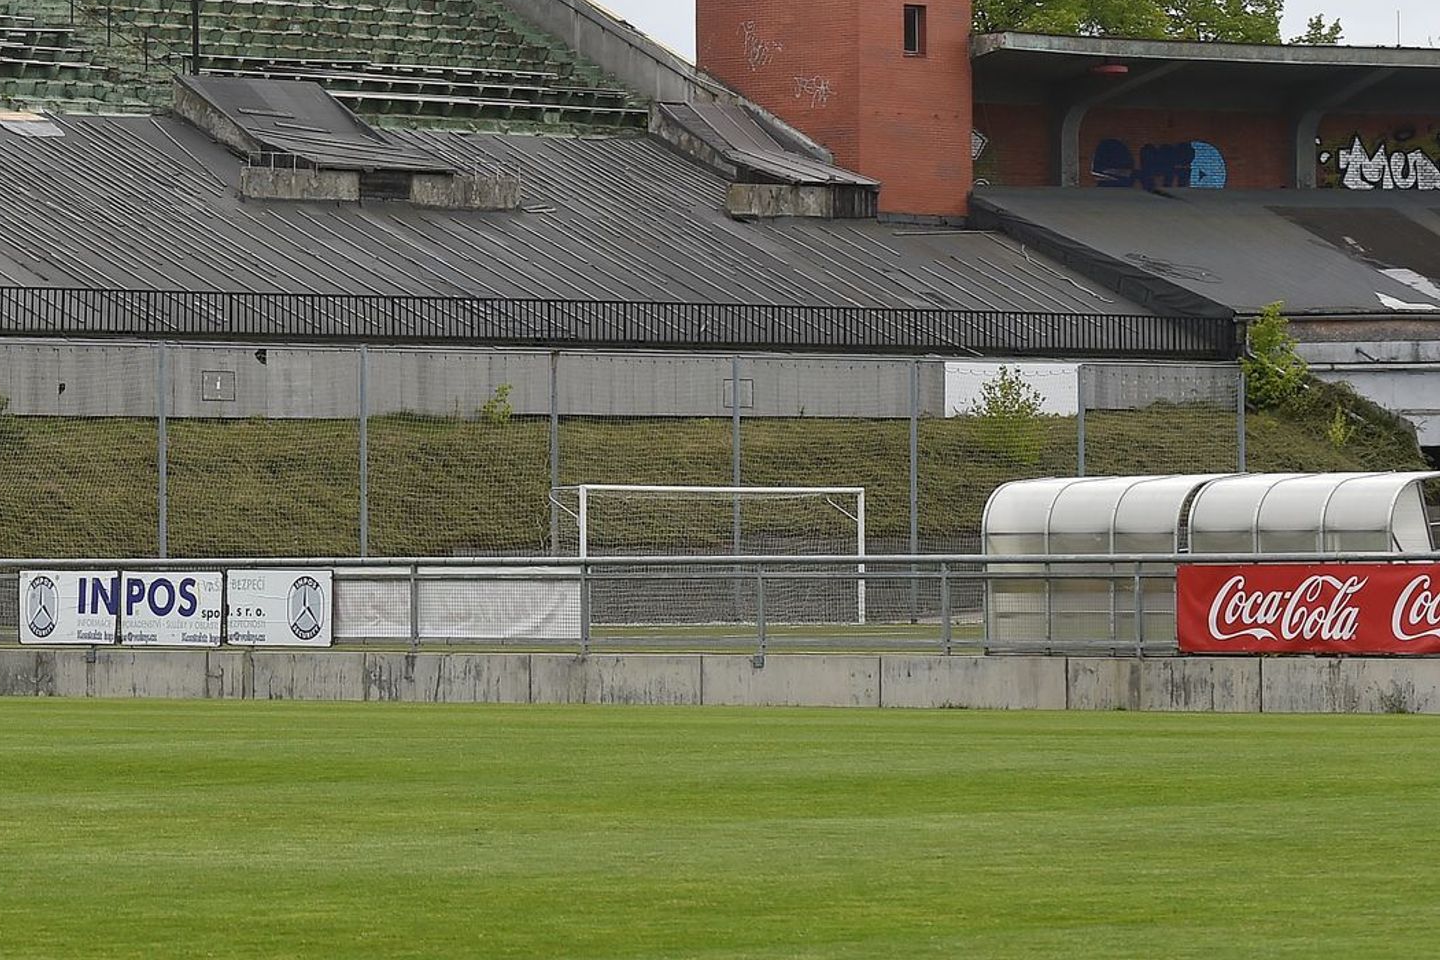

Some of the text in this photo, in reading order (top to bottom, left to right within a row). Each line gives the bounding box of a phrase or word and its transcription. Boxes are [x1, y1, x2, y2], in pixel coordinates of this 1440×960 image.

[78, 577, 198, 617] INPOS
[236, 607, 242, 617] s
[1208, 574, 1369, 641] Coca-Cola
